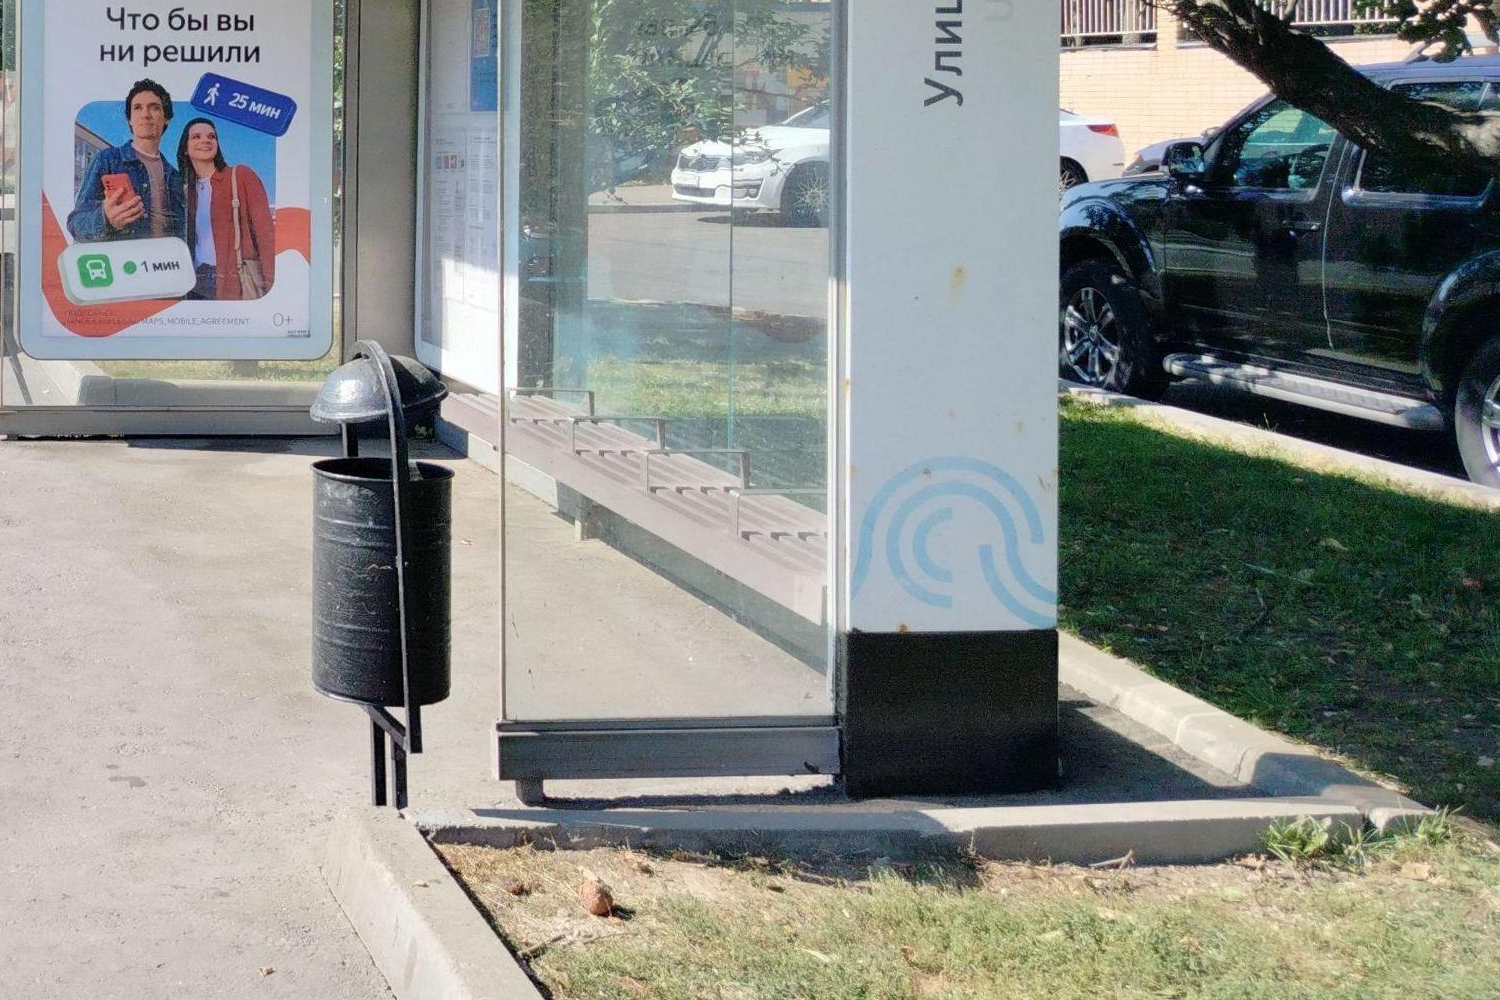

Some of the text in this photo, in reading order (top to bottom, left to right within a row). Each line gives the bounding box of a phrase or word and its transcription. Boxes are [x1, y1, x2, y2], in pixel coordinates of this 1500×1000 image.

[106, 6, 254, 31] Что бы вы
[99, 44, 261, 68] ни решили
[228, 92, 281, 120] 25 мин
[141, 260, 180, 272] 1 мин
[272, 312, 293, 327] 0+
